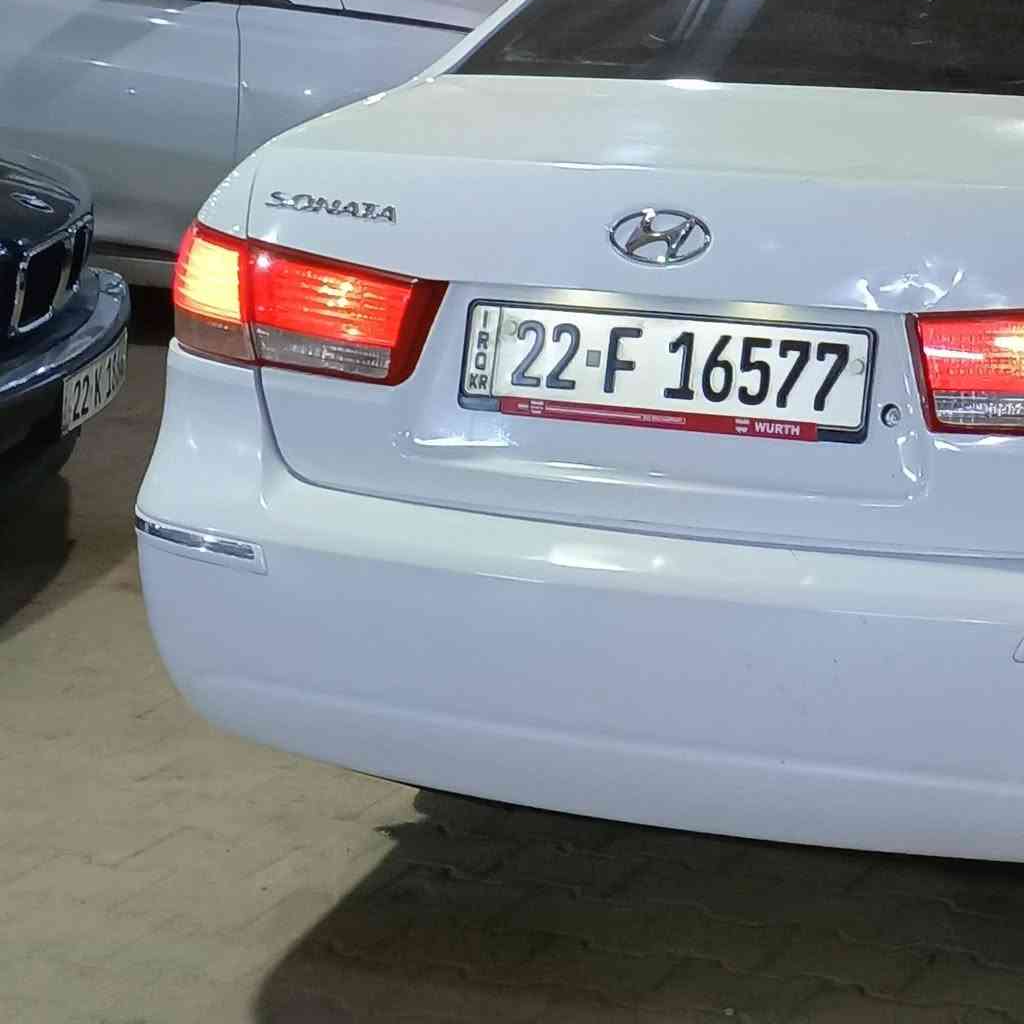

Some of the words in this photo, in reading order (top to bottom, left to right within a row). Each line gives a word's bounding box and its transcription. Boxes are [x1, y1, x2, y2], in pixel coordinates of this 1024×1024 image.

[265, 191, 397, 225] SONATA
[663, 331, 850, 412] 16577
[754, 421, 801, 436] WURTH
